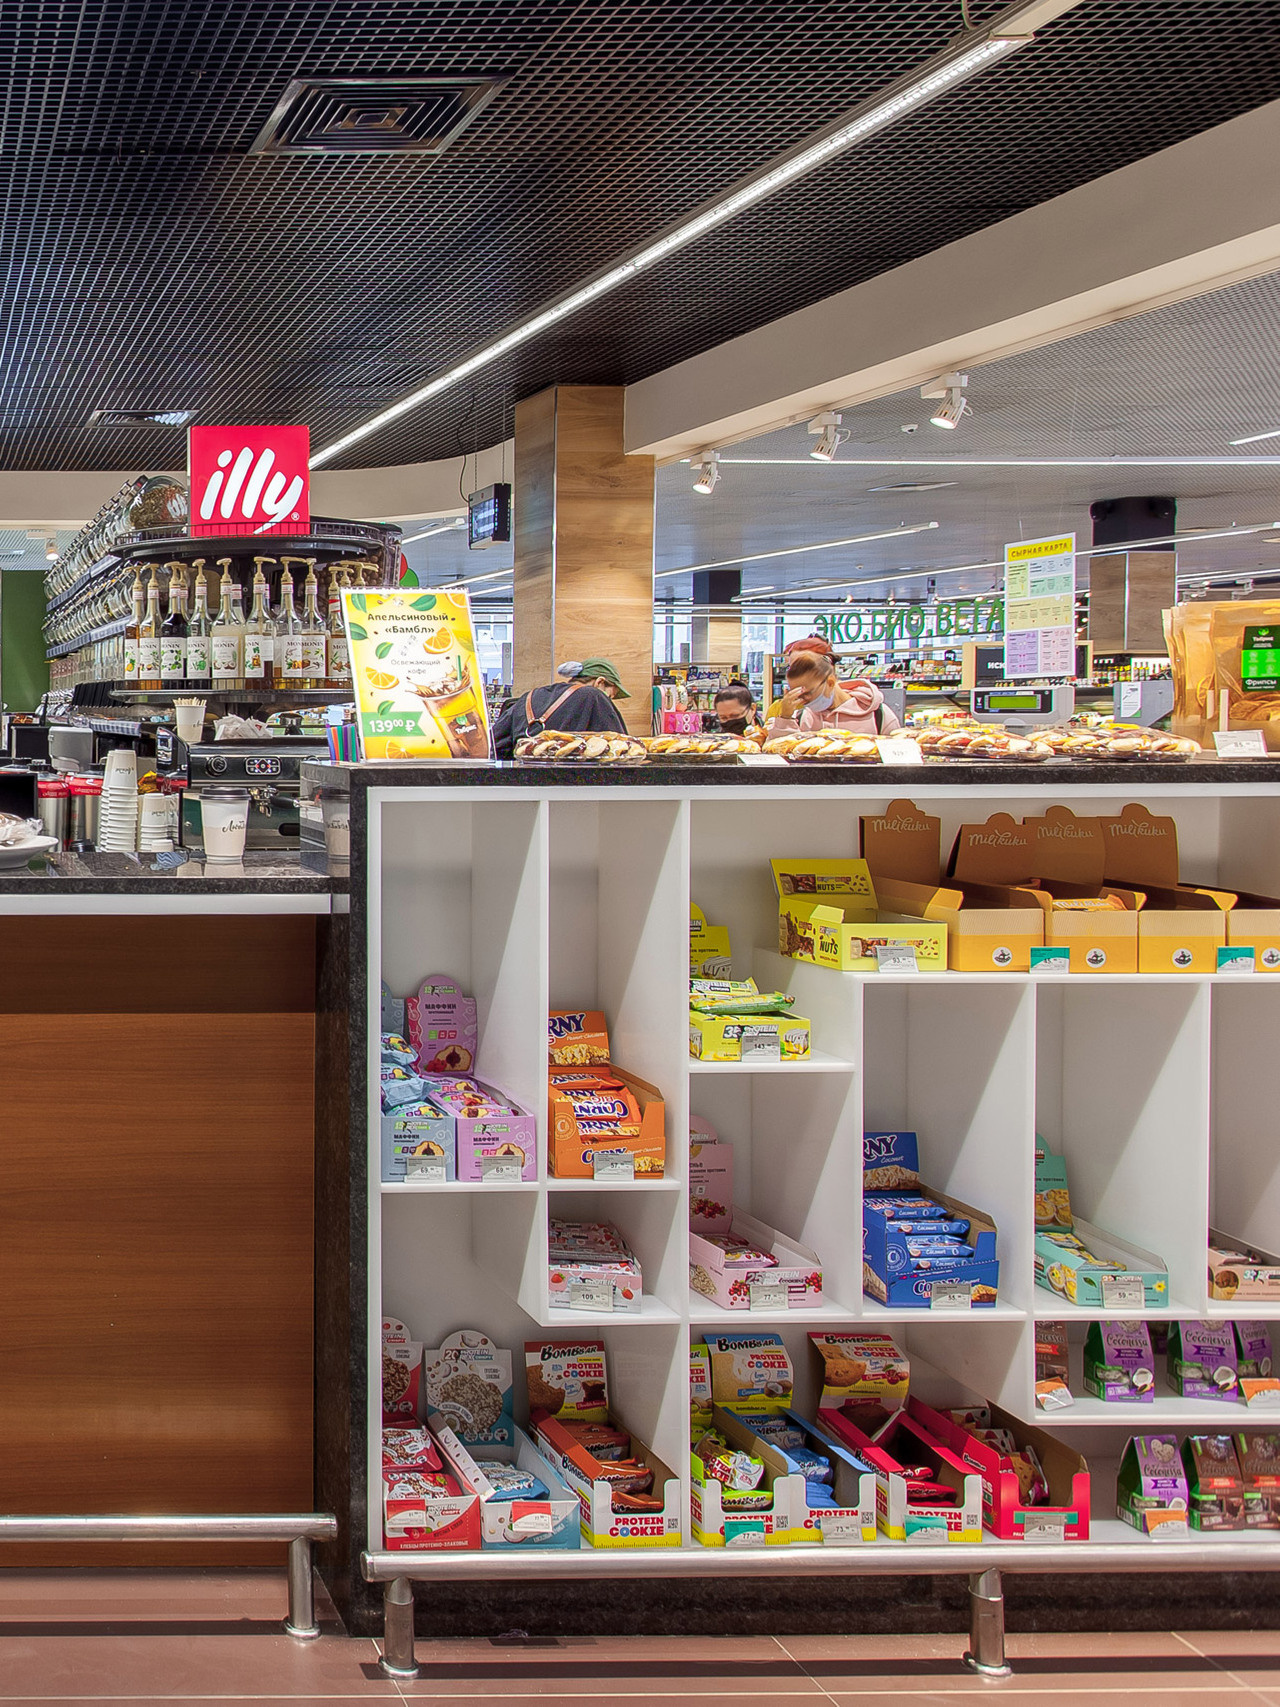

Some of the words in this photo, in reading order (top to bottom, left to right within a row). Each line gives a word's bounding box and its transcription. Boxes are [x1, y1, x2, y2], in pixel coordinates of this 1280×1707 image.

[199, 446, 304, 534] illy
[1011, 546, 1041, 558] СЫРНАЯ
[1044, 541, 1067, 552] КАРТА
[368, 612, 449, 622] Апельсиновый
[385, 626, 435, 634] «Бамбл»
[391, 658, 441, 667] Освежающий
[817, 883, 835, 891] NUTS
[820, 939, 839, 956] NUTS
[563, 1370, 604, 1378] COOKIE
[1144, 1462, 1182, 1477] Coconessa
[809, 1510, 858, 1518] PROTEIN
[615, 1517, 664, 1525] PROTEIN
[609, 1526, 664, 1537] COOKIE
